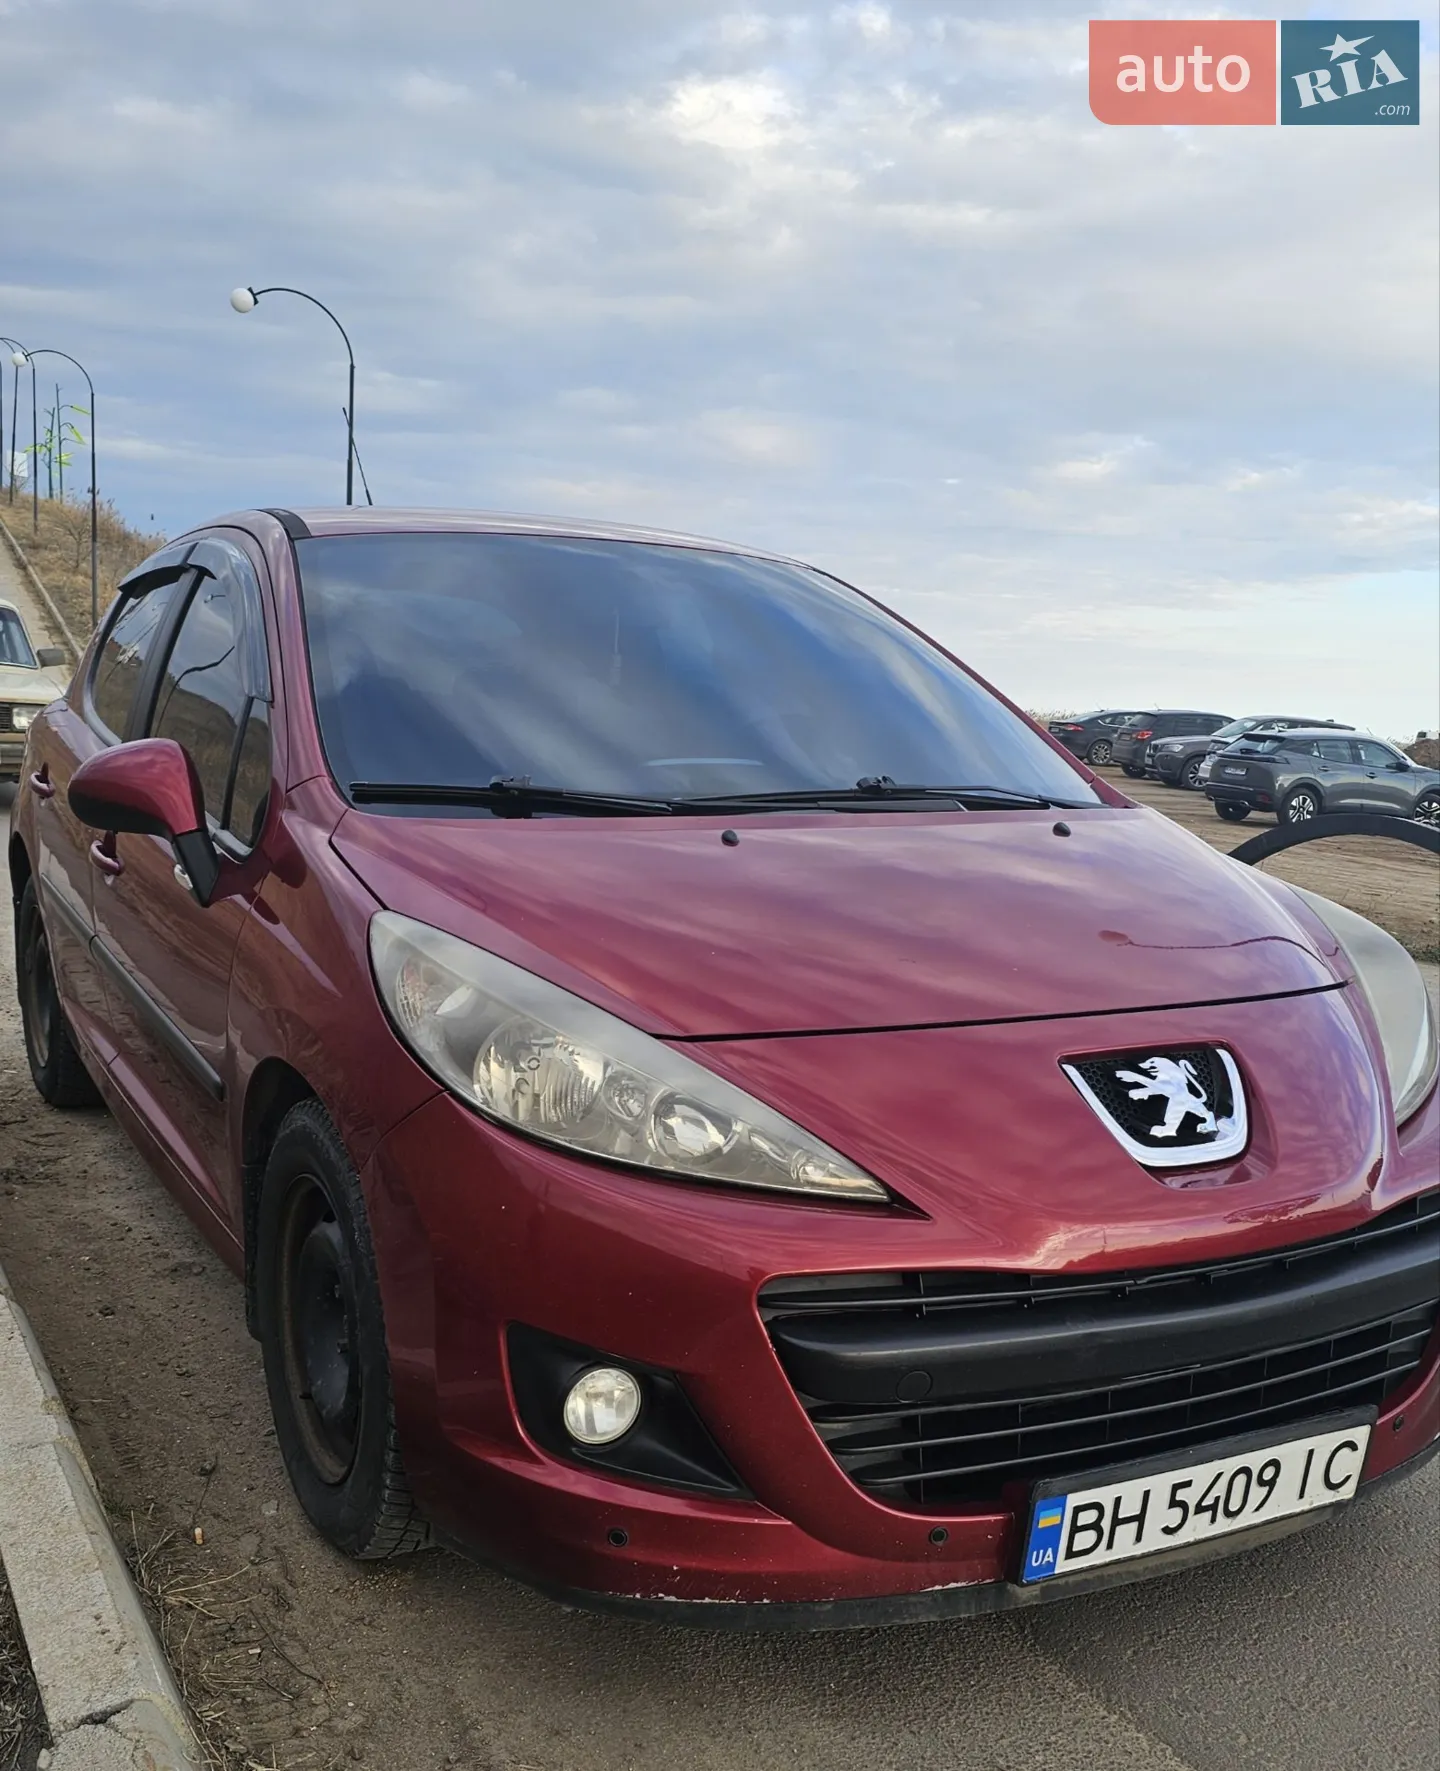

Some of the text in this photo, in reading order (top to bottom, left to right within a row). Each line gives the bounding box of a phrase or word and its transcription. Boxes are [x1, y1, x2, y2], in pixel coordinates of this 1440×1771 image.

[1063, 1439, 1359, 1561] BH 5409 IC
[1031, 1547, 1054, 1567] UA
